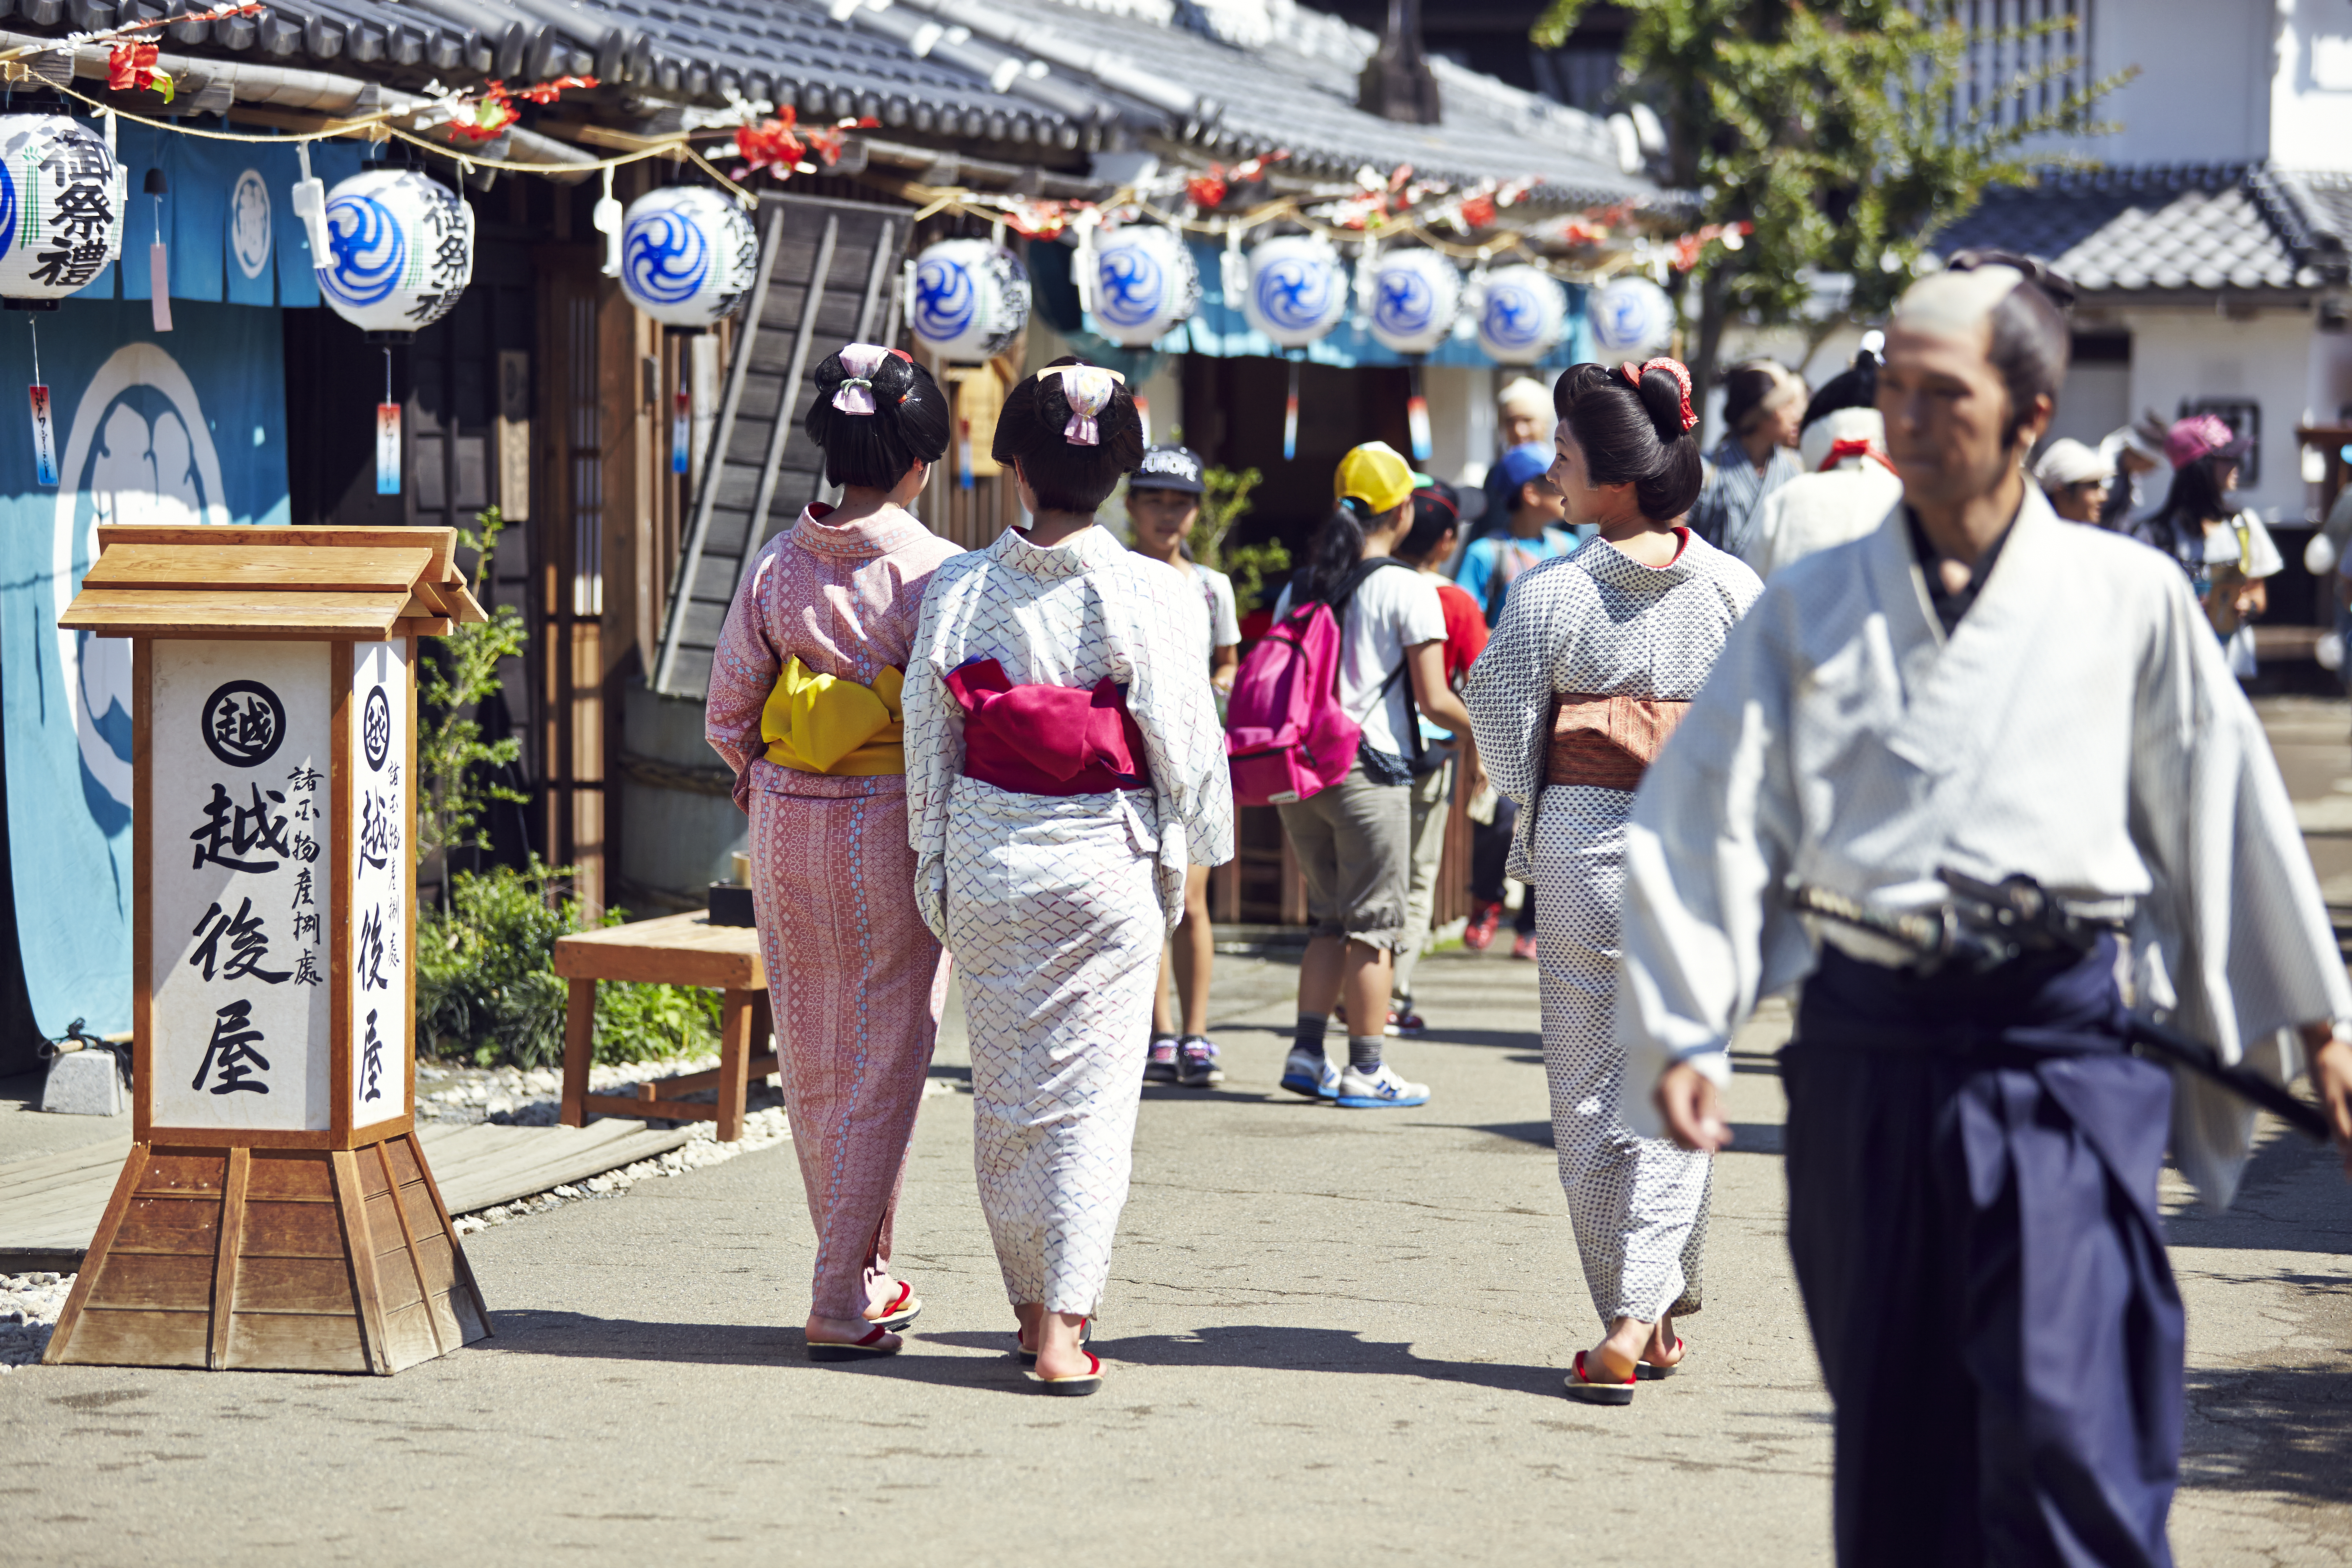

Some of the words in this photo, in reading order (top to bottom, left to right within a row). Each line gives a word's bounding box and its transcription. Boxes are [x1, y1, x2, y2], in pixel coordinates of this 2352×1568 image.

[29, 129, 113, 286] 御祭禮
[1141, 455, 1198, 482] UROPE
[215, 696, 272, 756] 越
[366, 704, 386, 755] 越
[190, 782, 294, 1095] 越後屋
[358, 785, 388, 1103] 越後屋
